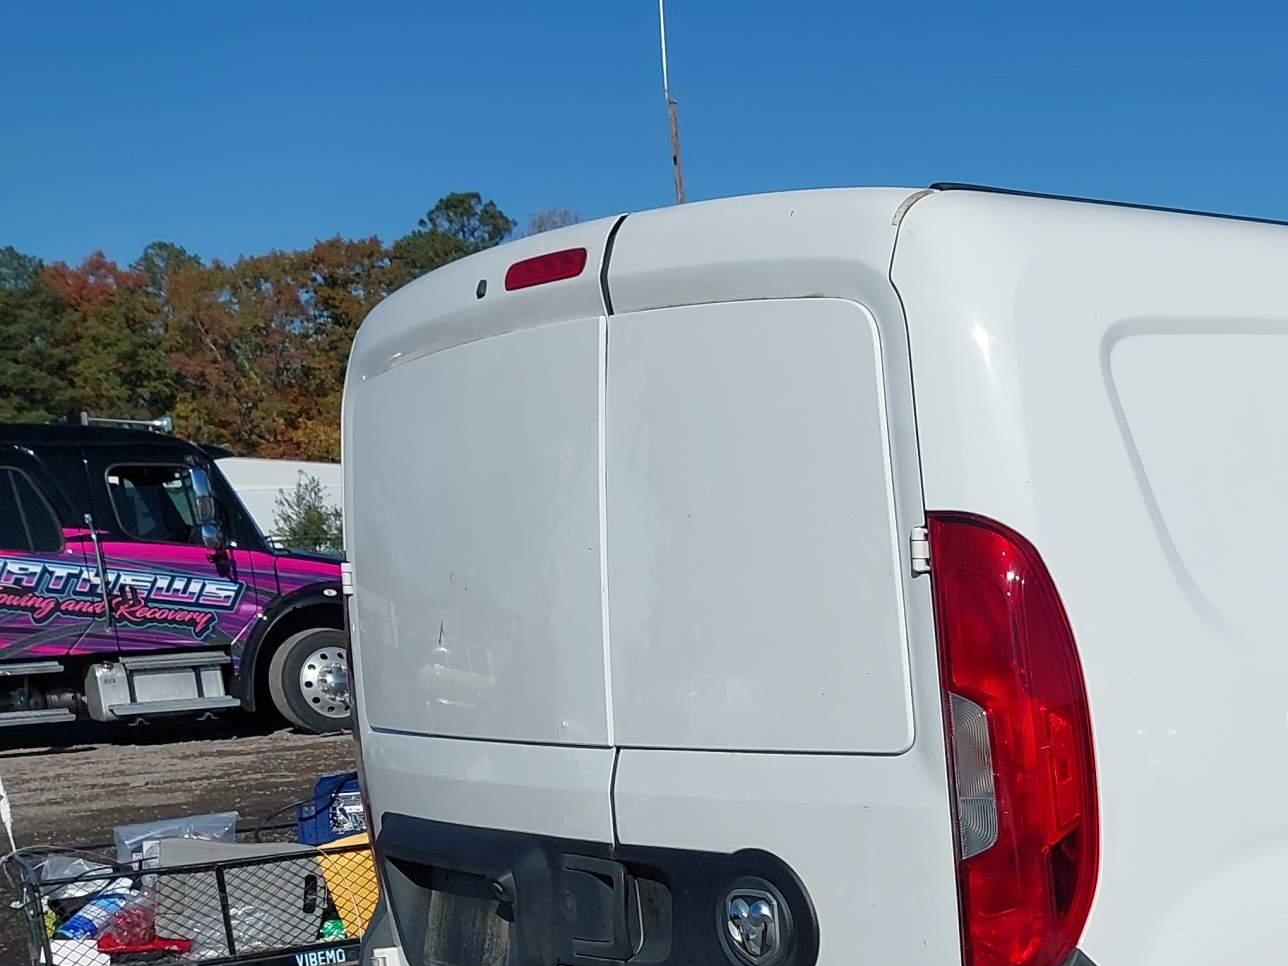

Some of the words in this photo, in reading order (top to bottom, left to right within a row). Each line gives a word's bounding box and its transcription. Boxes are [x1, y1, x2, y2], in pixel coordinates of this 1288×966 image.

[0, 559, 240, 606] ATHEWS
[0, 592, 56, 619] owing
[112, 598, 212, 633] Recovery
